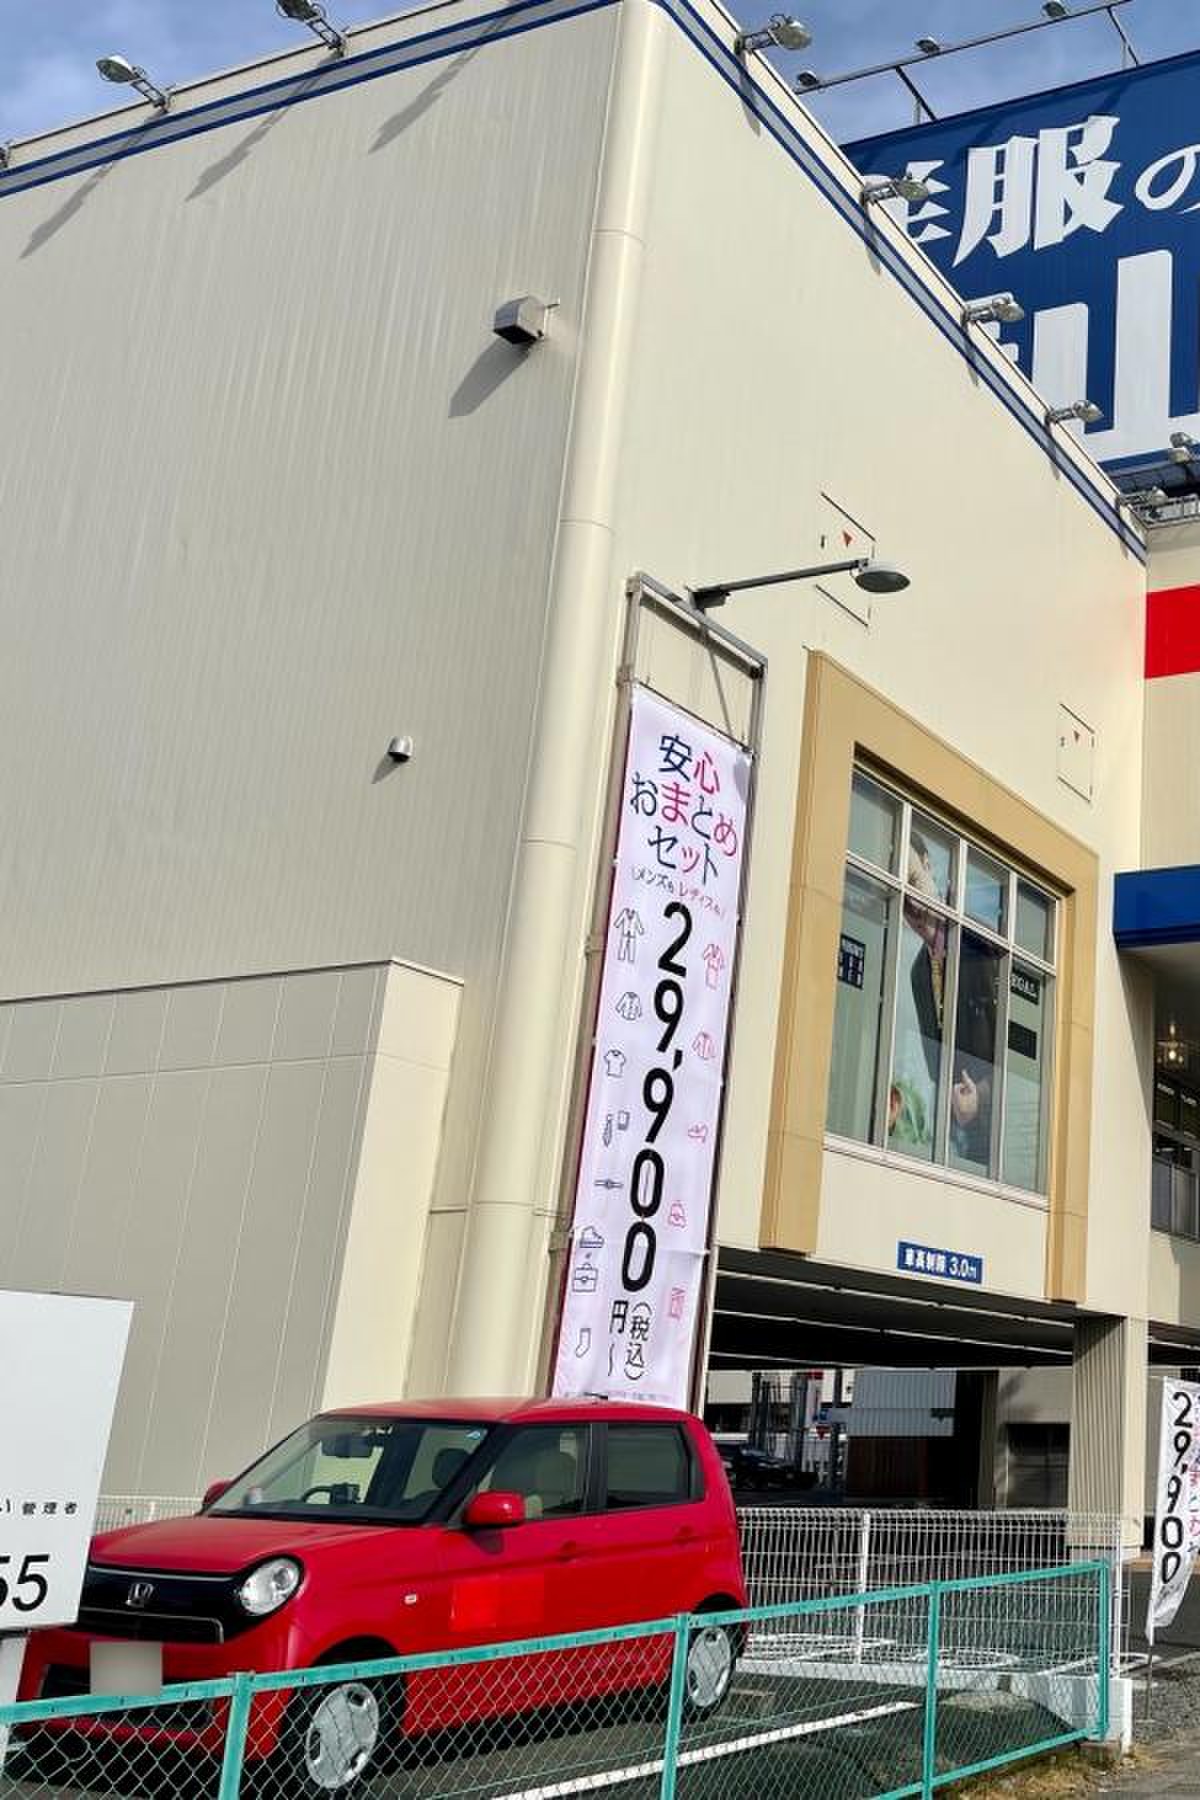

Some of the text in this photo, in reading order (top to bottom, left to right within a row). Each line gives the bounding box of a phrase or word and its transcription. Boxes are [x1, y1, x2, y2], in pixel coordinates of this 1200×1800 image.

[658, 733, 720, 796] 安心
[630, 771, 737, 858] おまとめ
[648, 825, 718, 886] セット
[621, 901, 693, 1293] 29,900
[1161, 1390, 1194, 1584] 29,900
